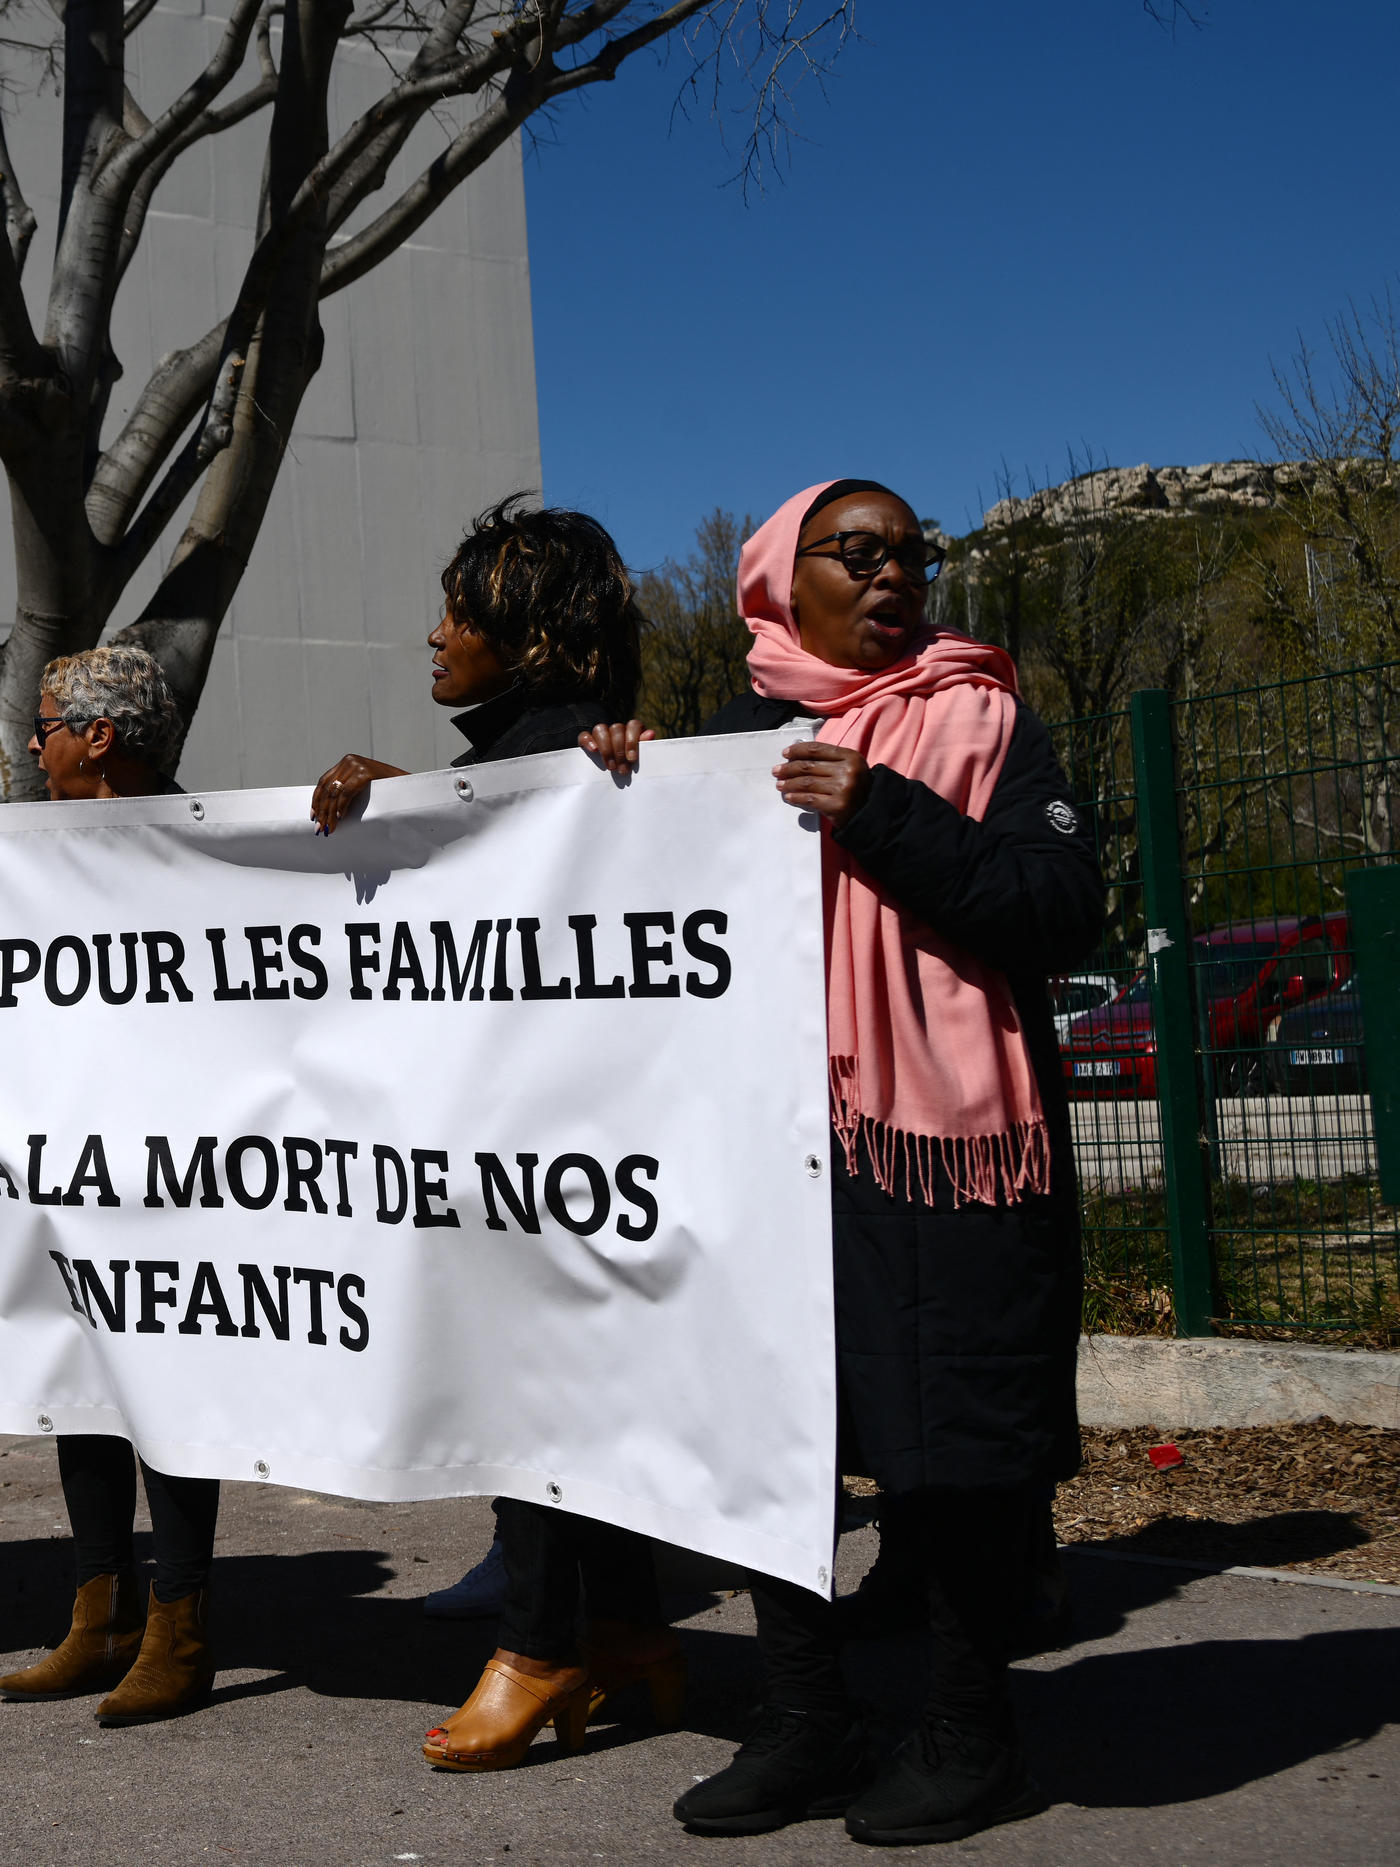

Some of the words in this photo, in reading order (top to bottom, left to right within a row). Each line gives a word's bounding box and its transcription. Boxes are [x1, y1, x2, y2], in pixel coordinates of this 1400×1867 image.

[205, 923, 329, 1002] LES
[344, 909, 732, 1002] FAMILLES
[27, 1134, 121, 1208] LA
[143, 1135, 359, 1218] MORT
[373, 1143, 462, 1229] DE
[474, 1151, 659, 1242] NOS
[48, 1249, 370, 1353] ENFANTS
